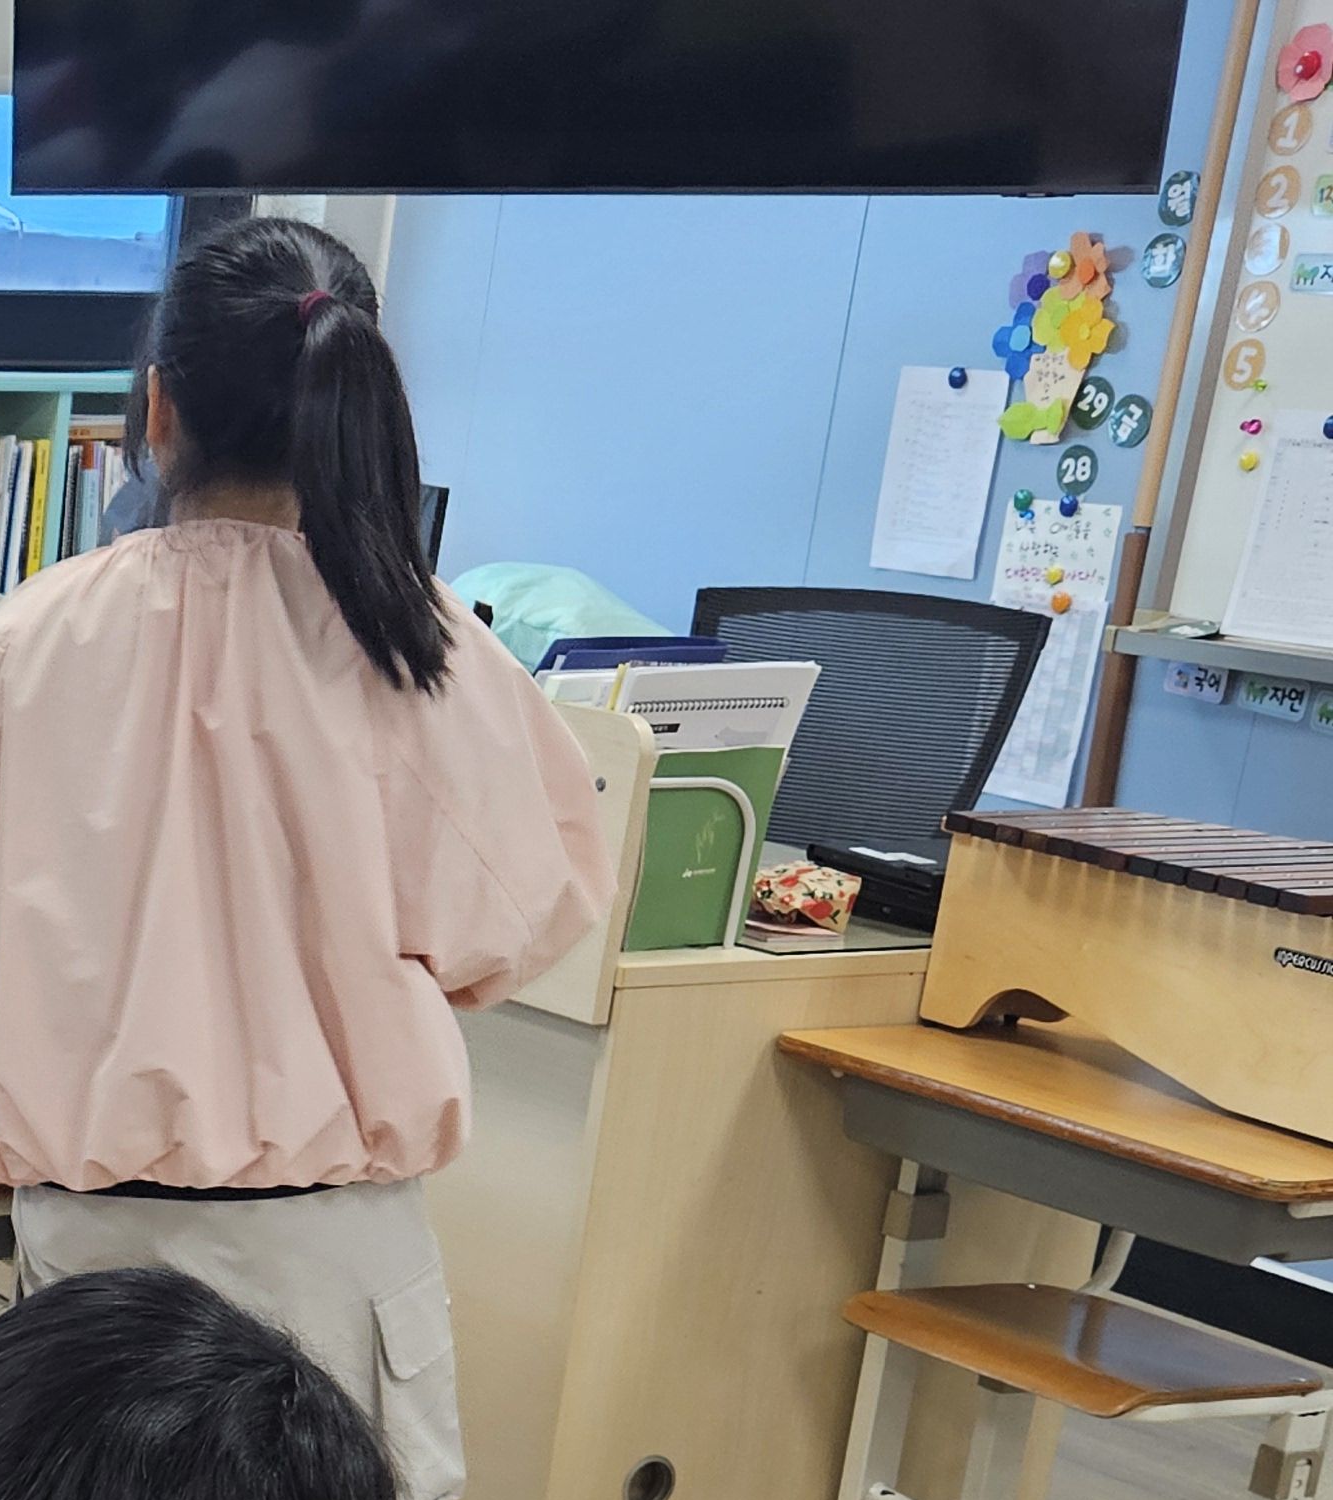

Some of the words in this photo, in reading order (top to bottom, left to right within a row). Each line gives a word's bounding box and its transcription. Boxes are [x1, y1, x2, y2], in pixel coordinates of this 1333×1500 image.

[1277, 110, 1301, 147] 1
[1168, 181, 1192, 217] 월
[1268, 174, 1290, 211] 2
[1232, 347, 1256, 386] 5
[1077, 384, 1109, 418] 29
[1116, 404, 1143, 441] 금
[1061, 456, 1092, 483] 28
[1194, 667, 1222, 693] 국어
[1269, 686, 1305, 713] 자연
